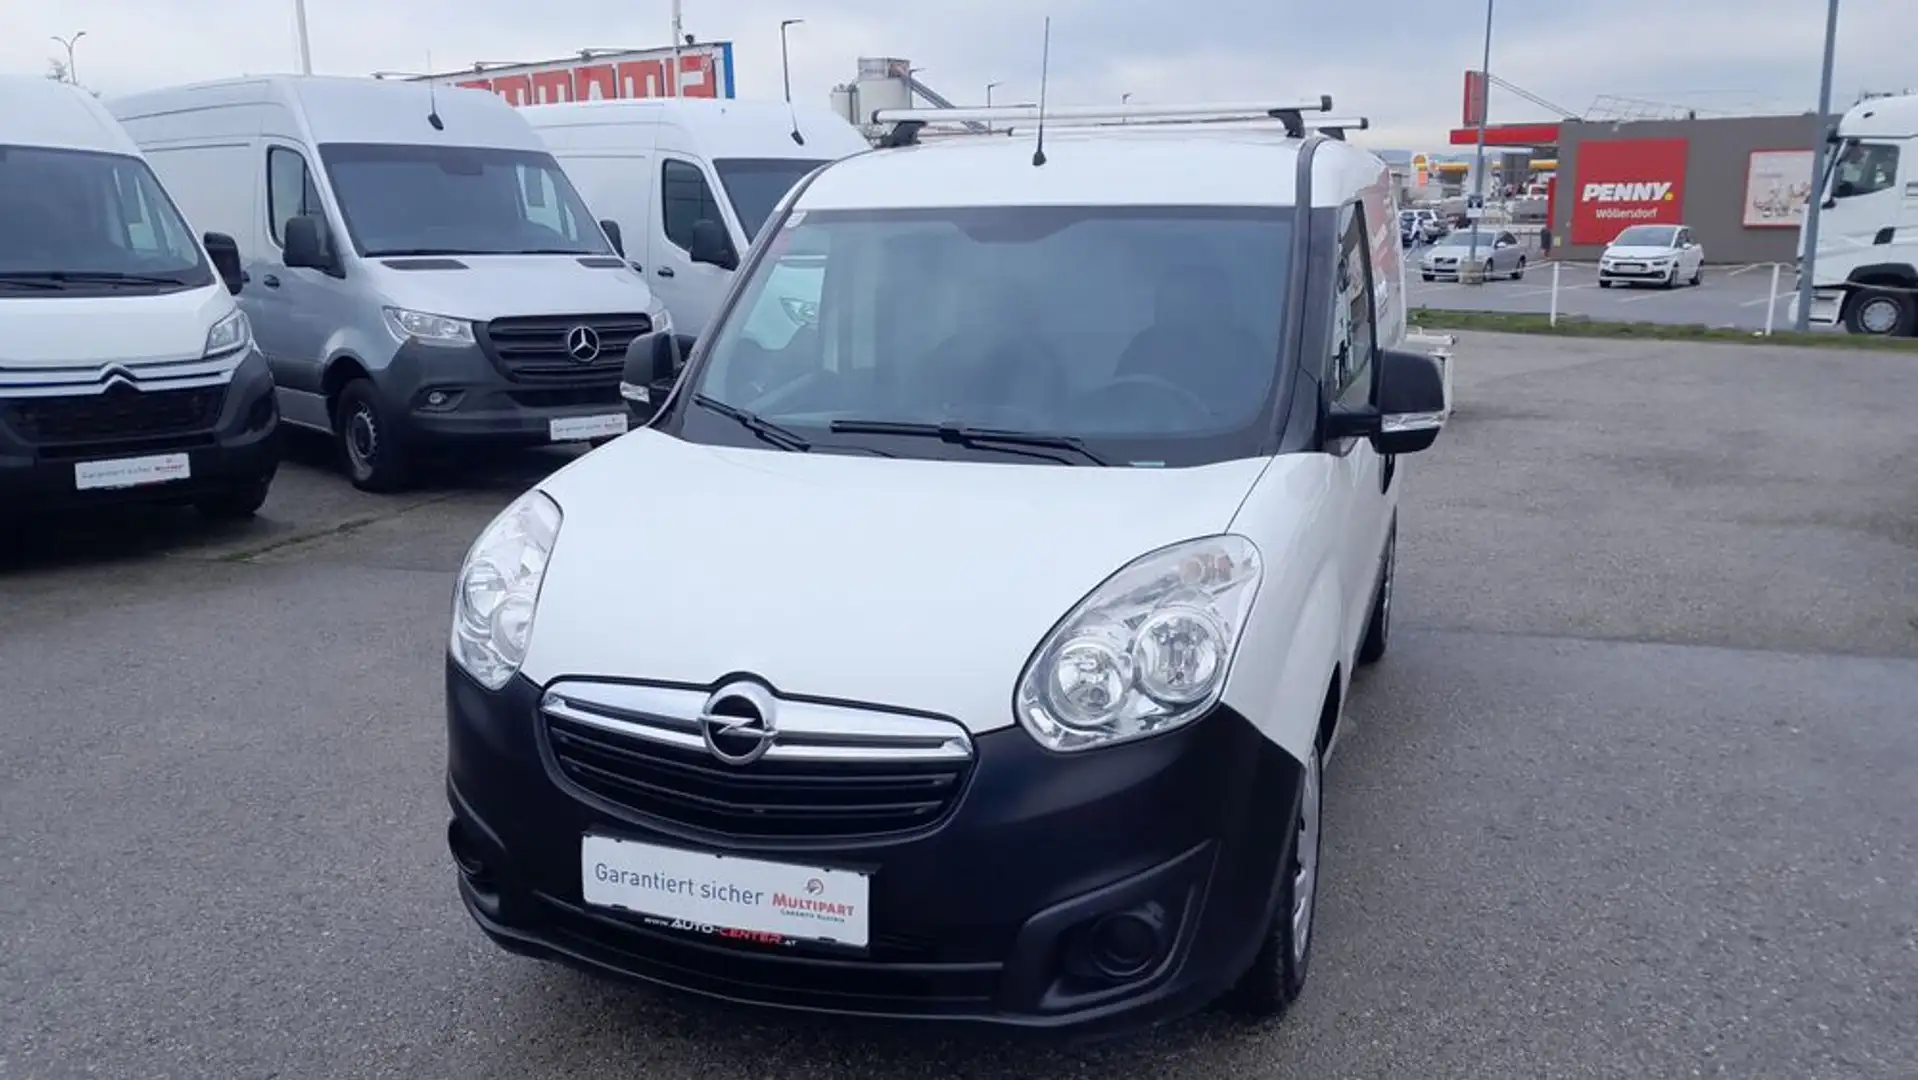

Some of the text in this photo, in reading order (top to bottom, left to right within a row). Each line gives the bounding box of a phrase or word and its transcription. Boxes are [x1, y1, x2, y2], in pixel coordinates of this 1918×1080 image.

[1595, 207, 1658, 219] Wöllersdorf
[595, 862, 765, 906] Garantiert sicher
